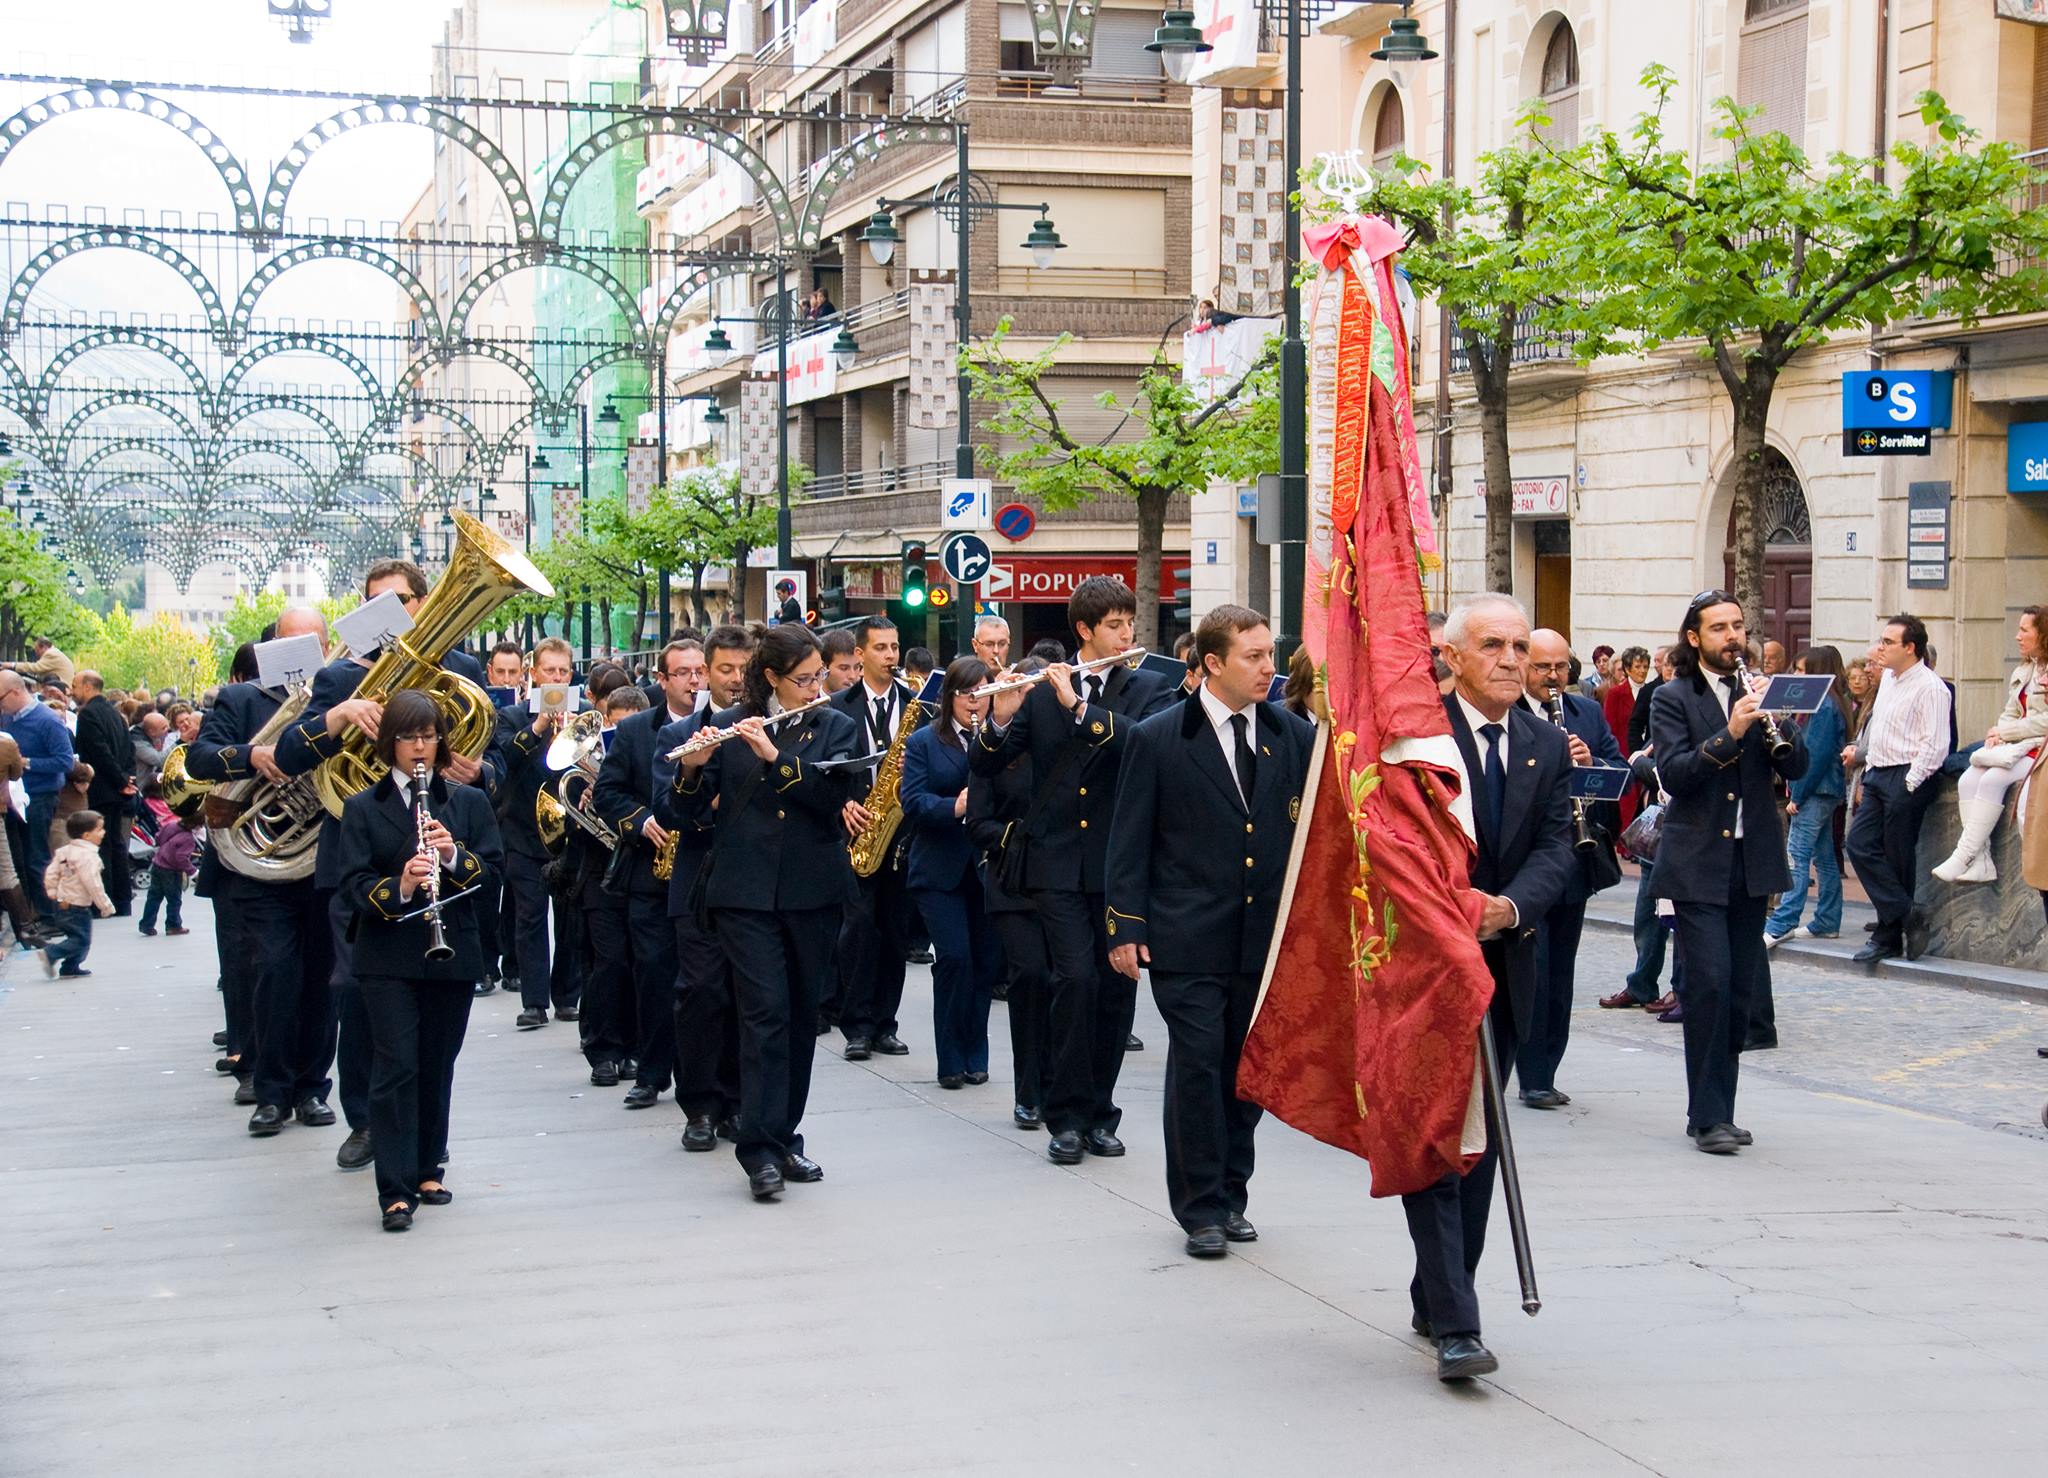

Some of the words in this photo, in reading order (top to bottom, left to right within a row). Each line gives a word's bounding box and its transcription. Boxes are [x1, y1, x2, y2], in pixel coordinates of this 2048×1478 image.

[1342, 279, 1367, 342] IESTAS
[1872, 383, 1882, 396] B
[1889, 382, 1917, 421] S
[1880, 435, 1926, 447] ServiRed
[1513, 482, 1544, 495] OCUTORIO
